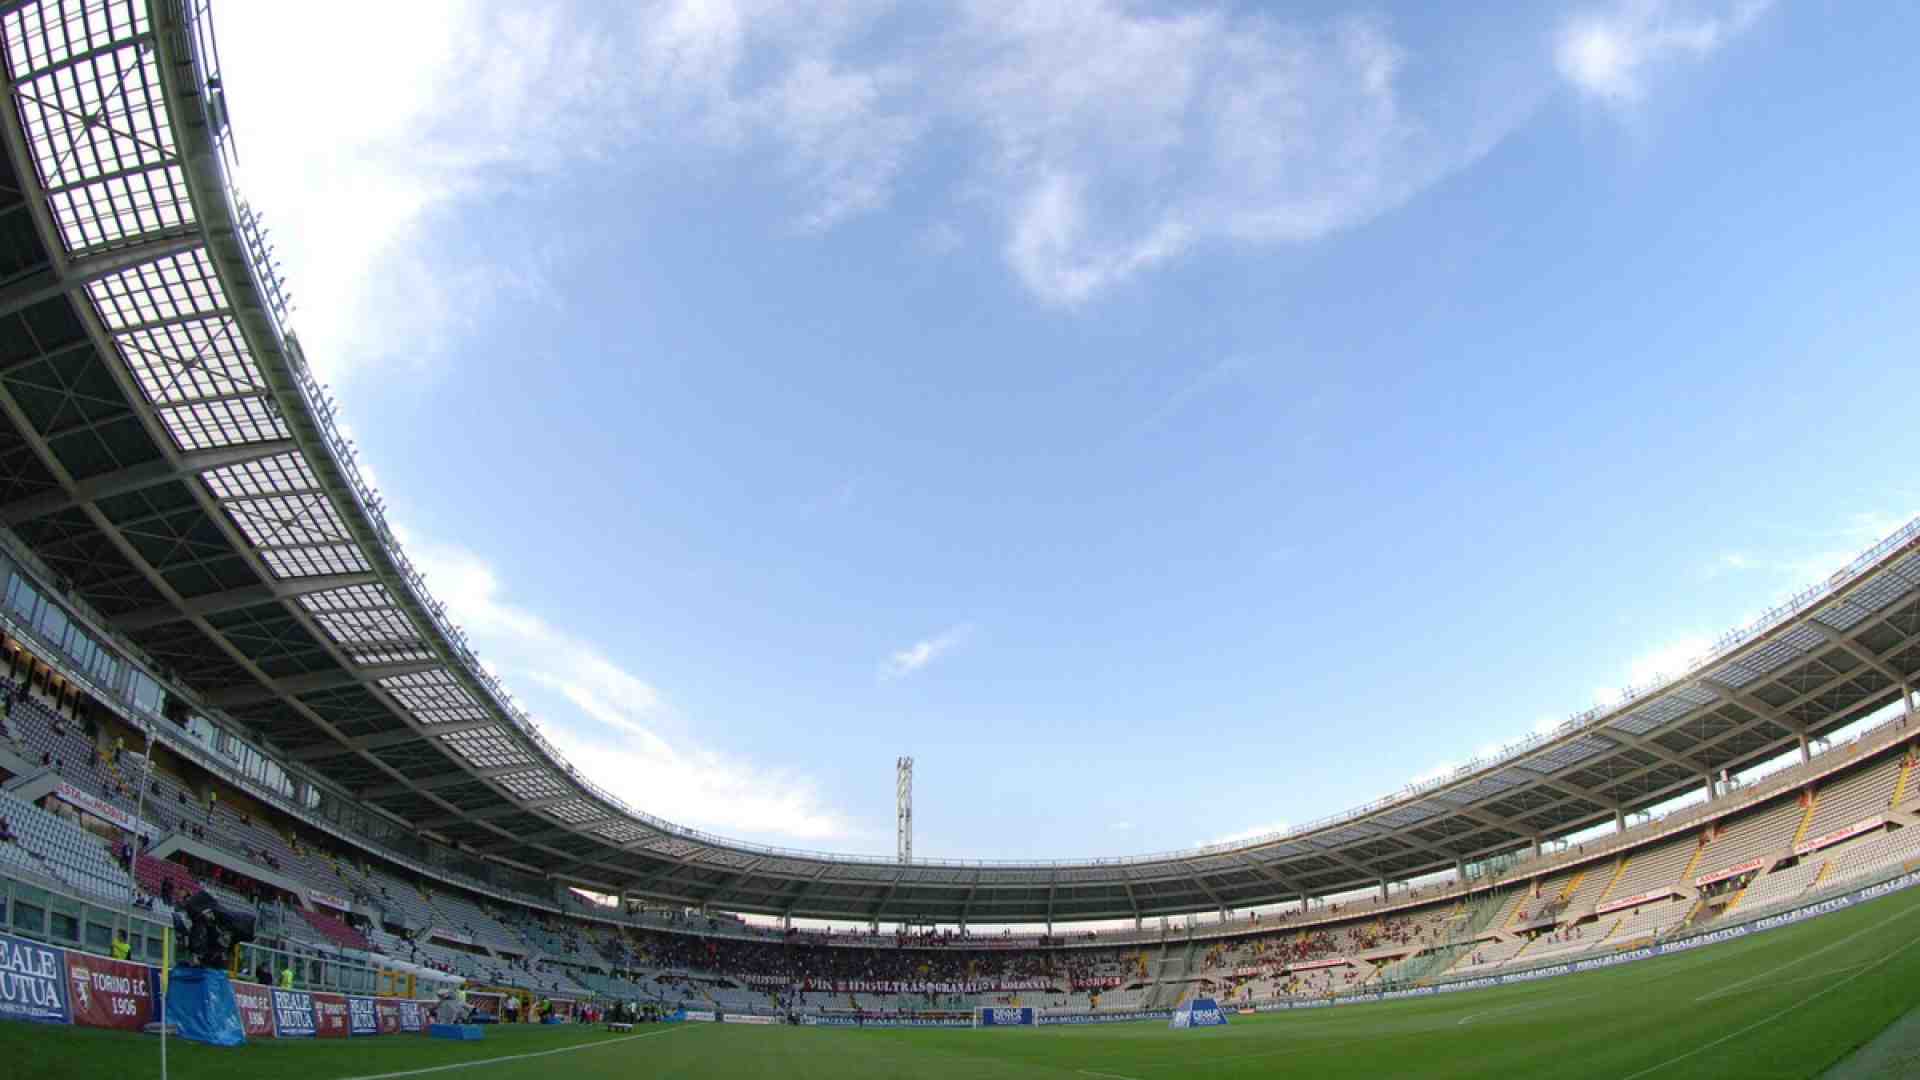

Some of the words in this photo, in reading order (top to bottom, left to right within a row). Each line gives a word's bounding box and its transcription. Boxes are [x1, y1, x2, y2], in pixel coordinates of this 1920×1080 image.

[0, 940, 57, 979] EALE
[0, 970, 62, 1009] UTUA
[91, 972, 130, 994] TORINO
[112, 996, 137, 1016] 1906
